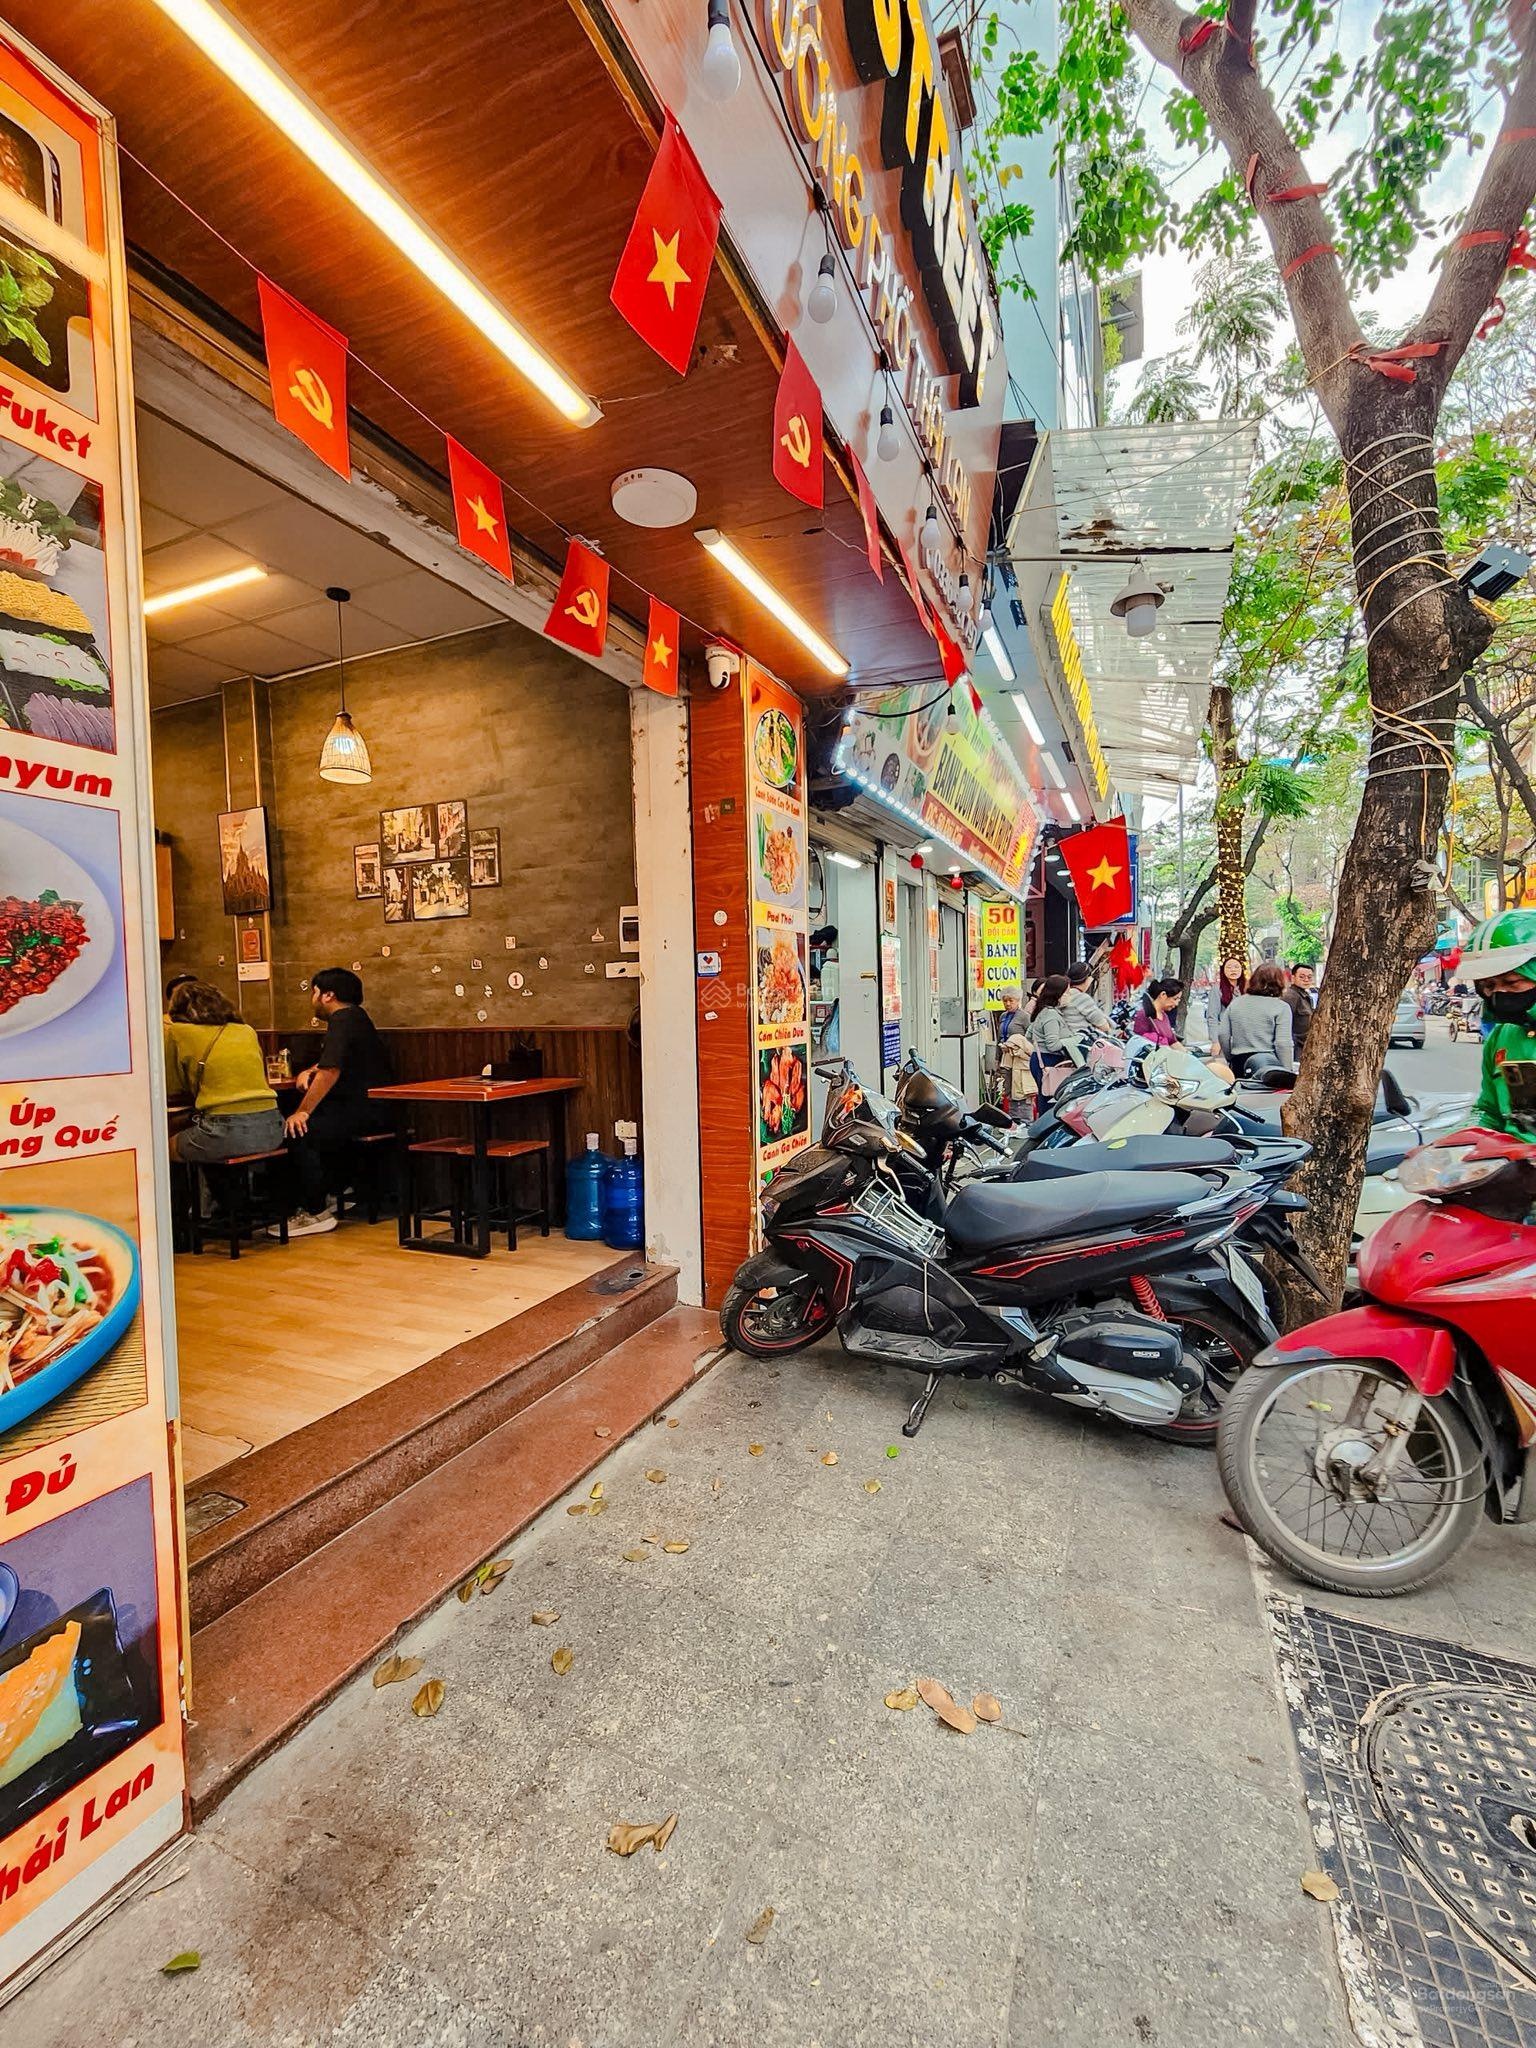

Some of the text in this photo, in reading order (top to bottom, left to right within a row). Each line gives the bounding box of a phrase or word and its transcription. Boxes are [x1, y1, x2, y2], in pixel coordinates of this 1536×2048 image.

[988, 907, 1015, 924] 50
[987, 940, 1017, 958] BÁNH
[513, 975, 519, 987] 1
[987, 961, 1017, 981] CUỐN
[9, 1097, 56, 1129] Úp
[55, 1115, 120, 1148] Quế
[5, 1453, 77, 1516] Đủ
[80, 1763, 155, 1841] Lan
